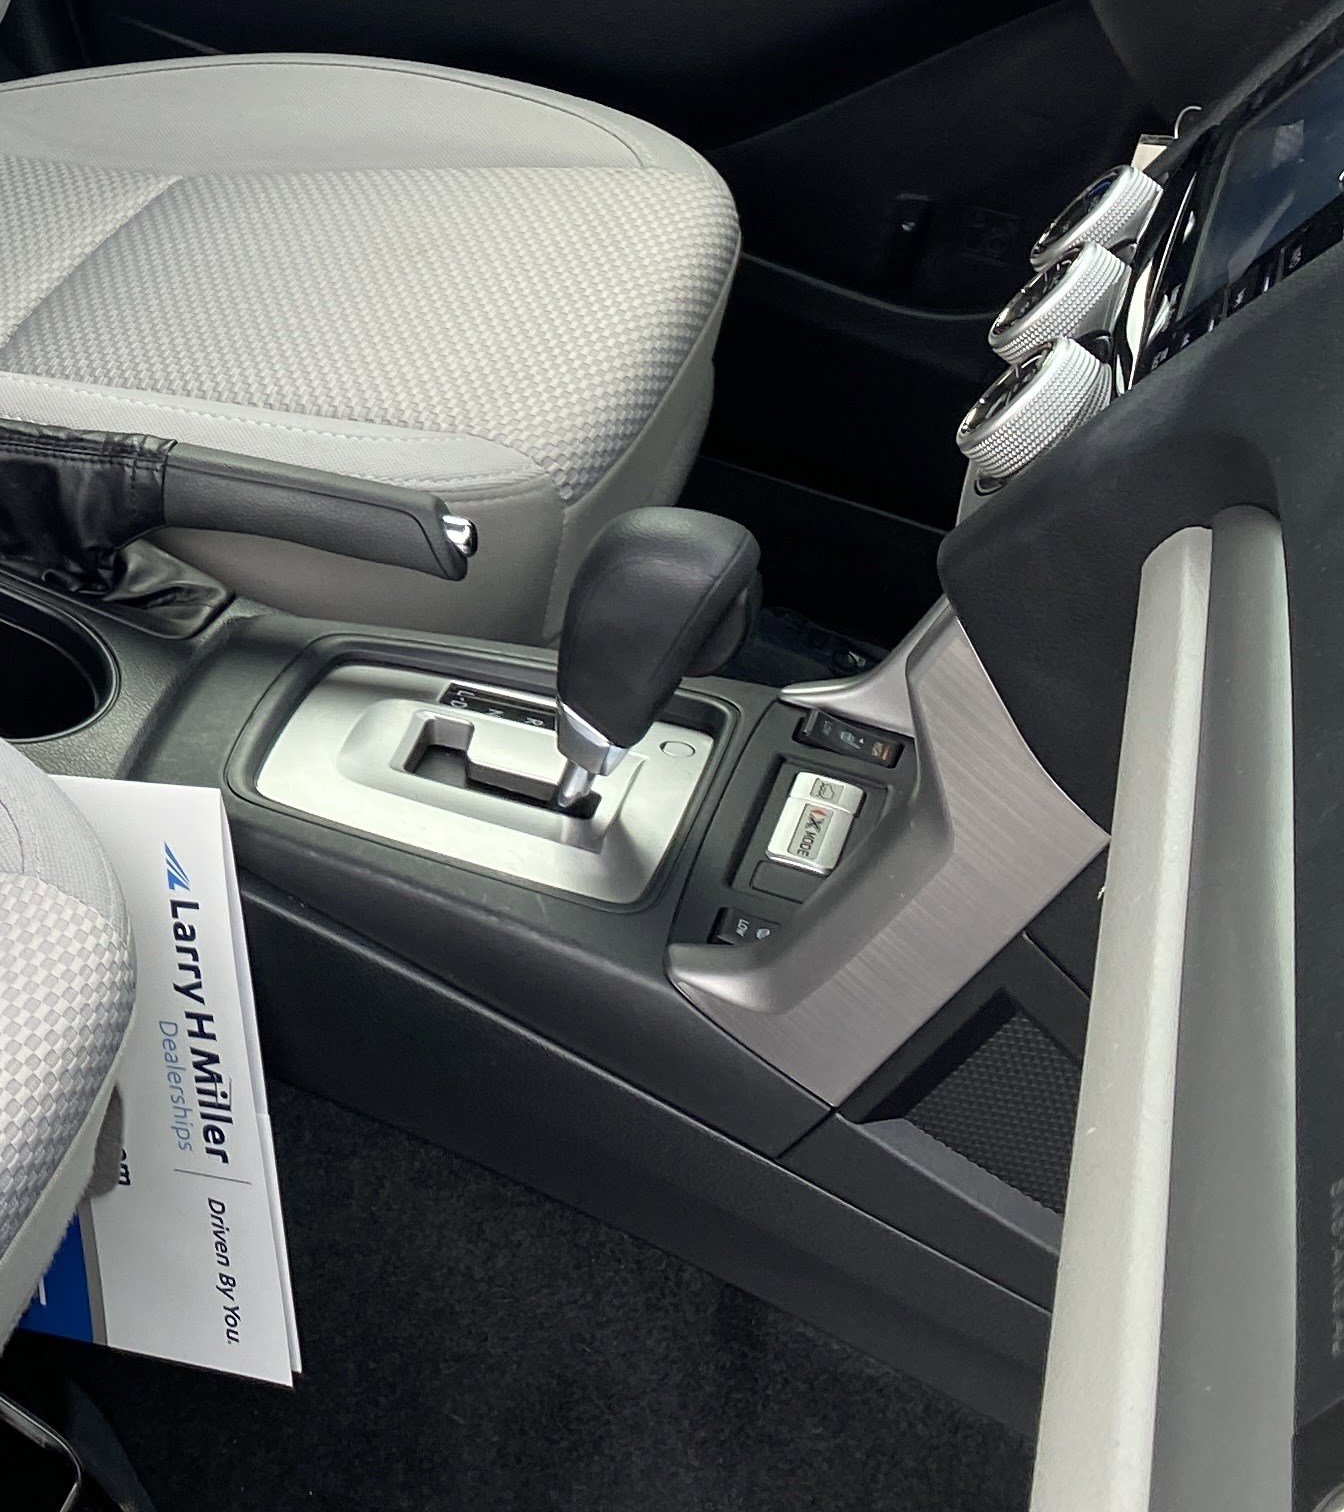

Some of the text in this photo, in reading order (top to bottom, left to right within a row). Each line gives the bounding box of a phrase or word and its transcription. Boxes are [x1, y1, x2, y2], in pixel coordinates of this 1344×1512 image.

[797, 830, 817, 857] MODE
[159, 1020, 193, 1152] Dealerships
[170, 899, 206, 1006] Larry
[189, 1045, 234, 1166] Miller
[207, 1197, 242, 1345] Driven By You.
